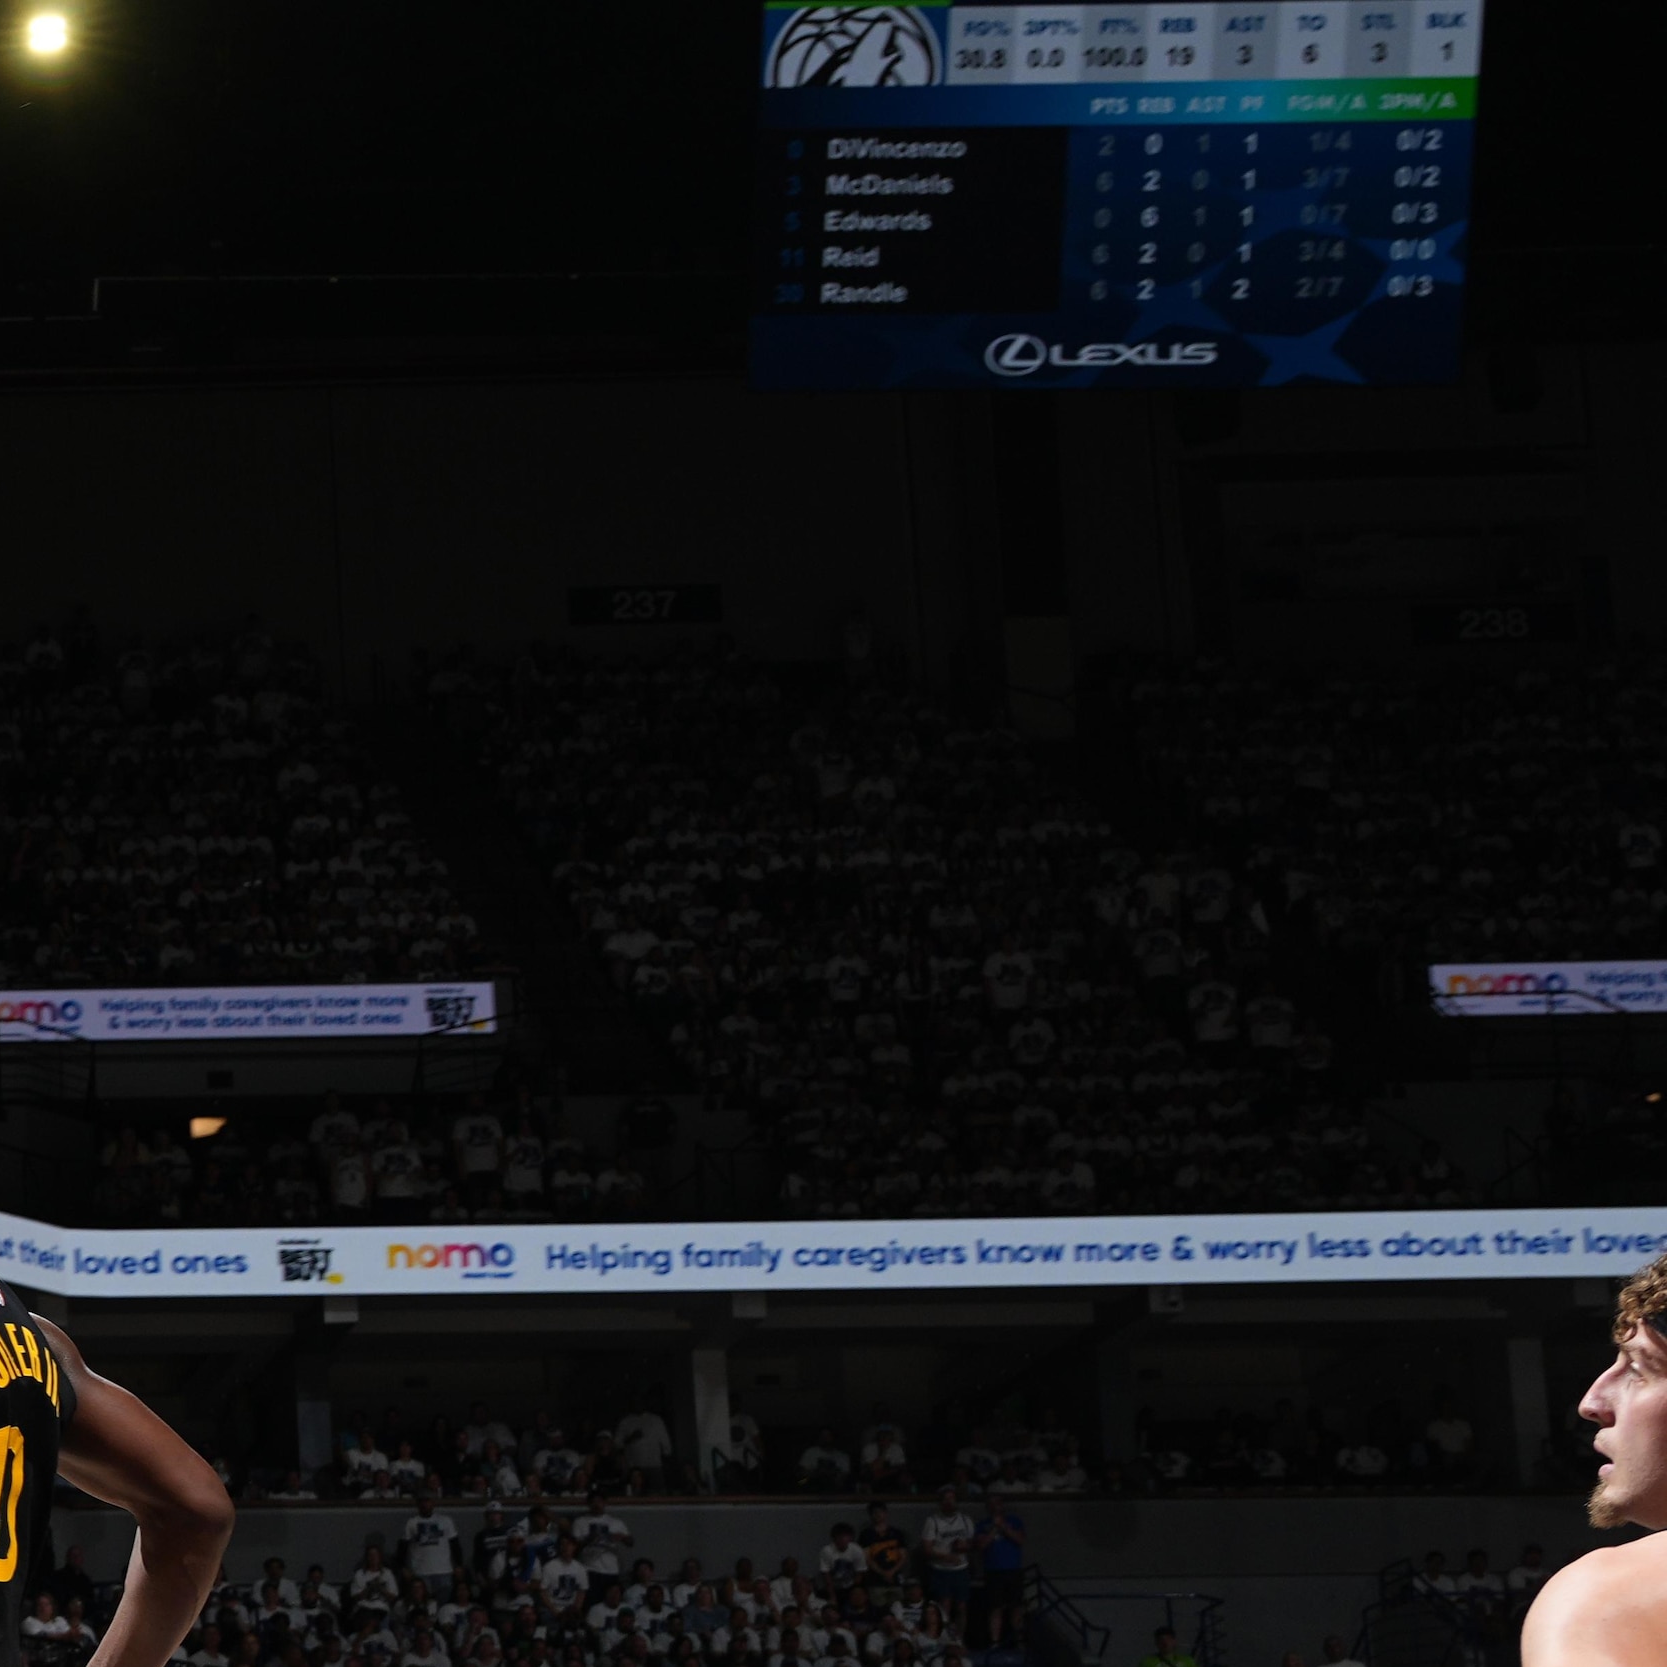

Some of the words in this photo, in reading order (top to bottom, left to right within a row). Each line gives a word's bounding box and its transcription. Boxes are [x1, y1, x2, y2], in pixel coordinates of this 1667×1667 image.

[1159, 17, 1197, 34] REB
[1226, 16, 1267, 33] AST
[1297, 15, 1328, 31] TO
[1361, 14, 1397, 31] STL
[1427, 12, 1467, 30] BLK
[1237, 44, 1254, 65] 3
[1302, 43, 1319, 64] 6
[1371, 42, 1388, 63] 3
[1441, 41, 1455, 62] 1
[1089, 97, 1131, 115] PTS
[1136, 96, 1177, 115] REB
[1185, 96, 1228, 114] AST
[1238, 95, 1267, 113] PF
[827, 137, 967, 160] DiVincenzo
[1243, 131, 1260, 155] 1
[1396, 128, 1444, 152] 0/2
[824, 173, 955, 196] McDaniels
[1141, 169, 1163, 192] 2
[1241, 168, 1258, 191] 1
[1393, 165, 1442, 189] 0/2
[822, 209, 934, 232] Edwards
[1239, 205, 1256, 228] 1
[1391, 201, 1440, 225] 0/3
[820, 246, 881, 269] Reid
[1137, 242, 1159, 265] 2
[1236, 241, 1253, 264] 1
[819, 281, 910, 304] Randle
[1135, 278, 1157, 301] 2
[1230, 278, 1252, 301] 2
[1386, 274, 1436, 298] 0/3
[1049, 342, 1219, 366] LEXUS
[612, 590, 675, 620] 237
[1458, 608, 1530, 640] 238
[19, 1237, 67, 1273] their
[73, 1246, 164, 1277] loved
[171, 1251, 250, 1276] ones
[278, 1247, 335, 1271] BEST
[386, 1241, 516, 1270] nomo
[545, 1241, 674, 1277] Helping
[681, 1241, 782, 1274] family
[792, 1239, 968, 1273] caregivers
[975, 1238, 1066, 1264] know
[1072, 1241, 1161, 1263] more
[1170, 1233, 1195, 1262] &
[1202, 1237, 1299, 1267] worry
[1306, 1231, 1371, 1260] less
[1379, 1230, 1486, 1259] about
[1493, 1227, 1574, 1257] their
[281, 1263, 328, 1284] BUY
